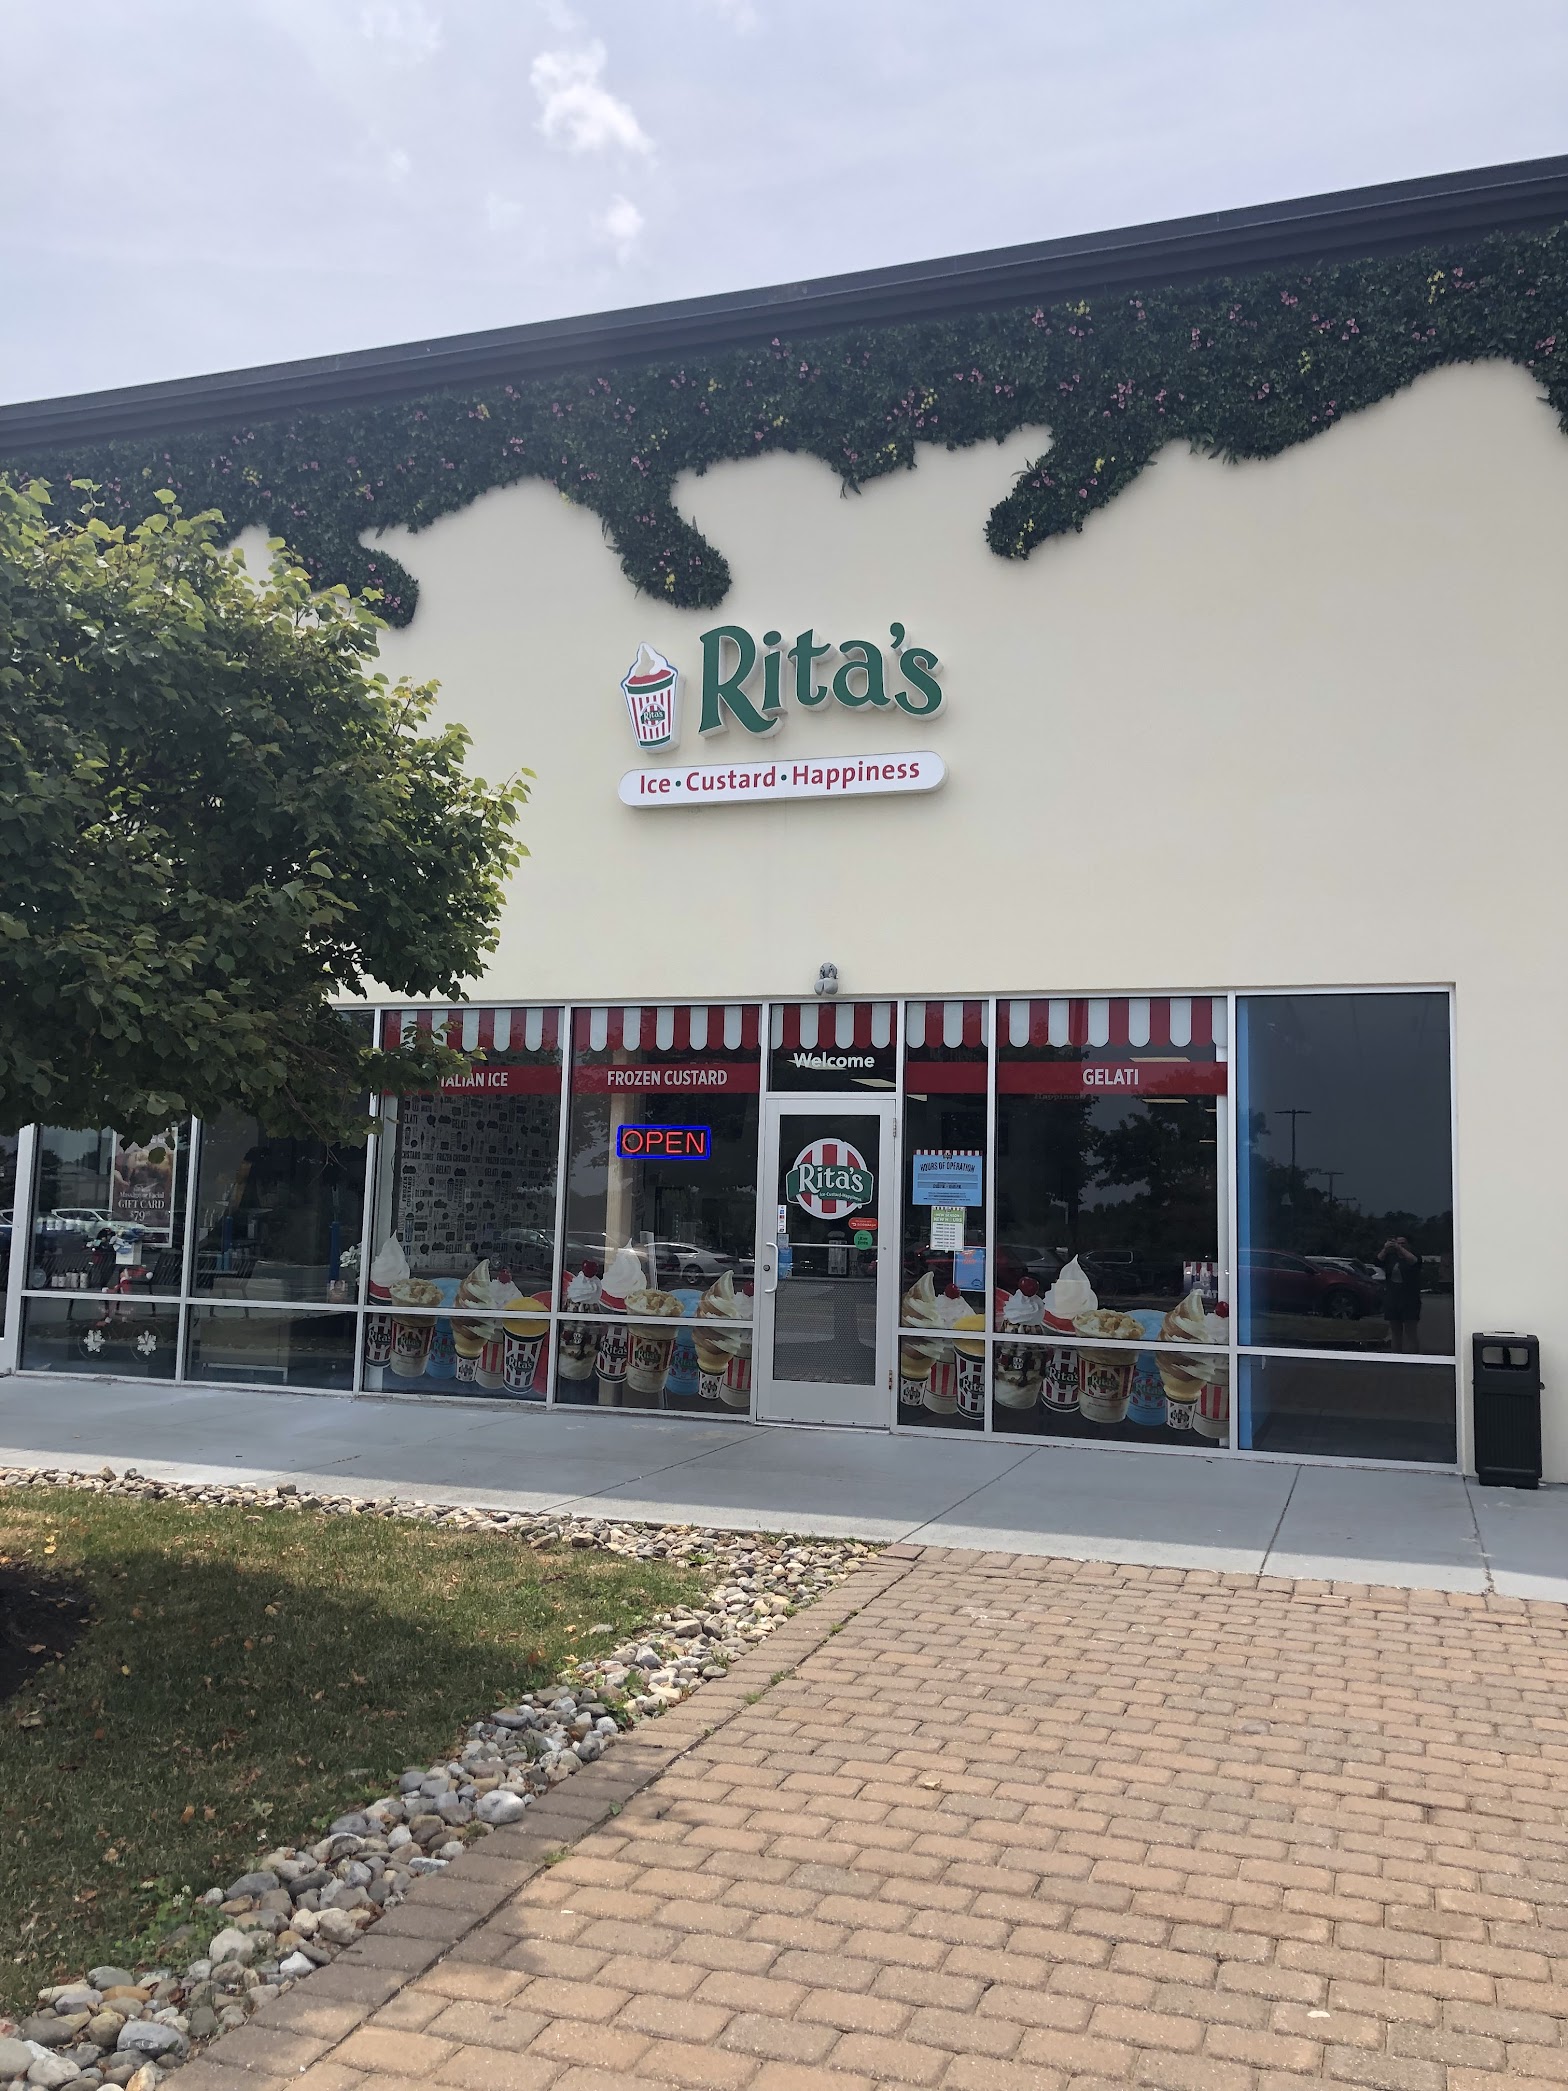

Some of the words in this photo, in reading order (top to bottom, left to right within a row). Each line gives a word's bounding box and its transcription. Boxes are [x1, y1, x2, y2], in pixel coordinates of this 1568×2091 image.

[699, 622, 944, 734] Rita's
[643, 709, 665, 722] Rita's
[640, 774, 671, 794] Ice
[686, 766, 776, 792] Custard
[792, 760, 920, 790] Happiness
[793, 1051, 876, 1068] Welcome
[437, 1072, 485, 1087] TALIAN
[488, 1072, 509, 1087] ICE
[607, 1070, 661, 1086] FROZEN
[664, 1070, 728, 1086] CUSTARD
[1082, 1068, 1139, 1086] GELATI
[622, 1130, 705, 1154] OPEN
[920, 1162, 938, 1172] HOURS
[939, 1161, 945, 1170] OF
[947, 1161, 976, 1173] OPERATION
[798, 1163, 865, 1194] Rita's
[118, 1199, 137, 1209] GIFT
[140, 1199, 165, 1209] CARD
[508, 1357, 533, 1371] Rita's
[963, 1378, 984, 1394] Rita
